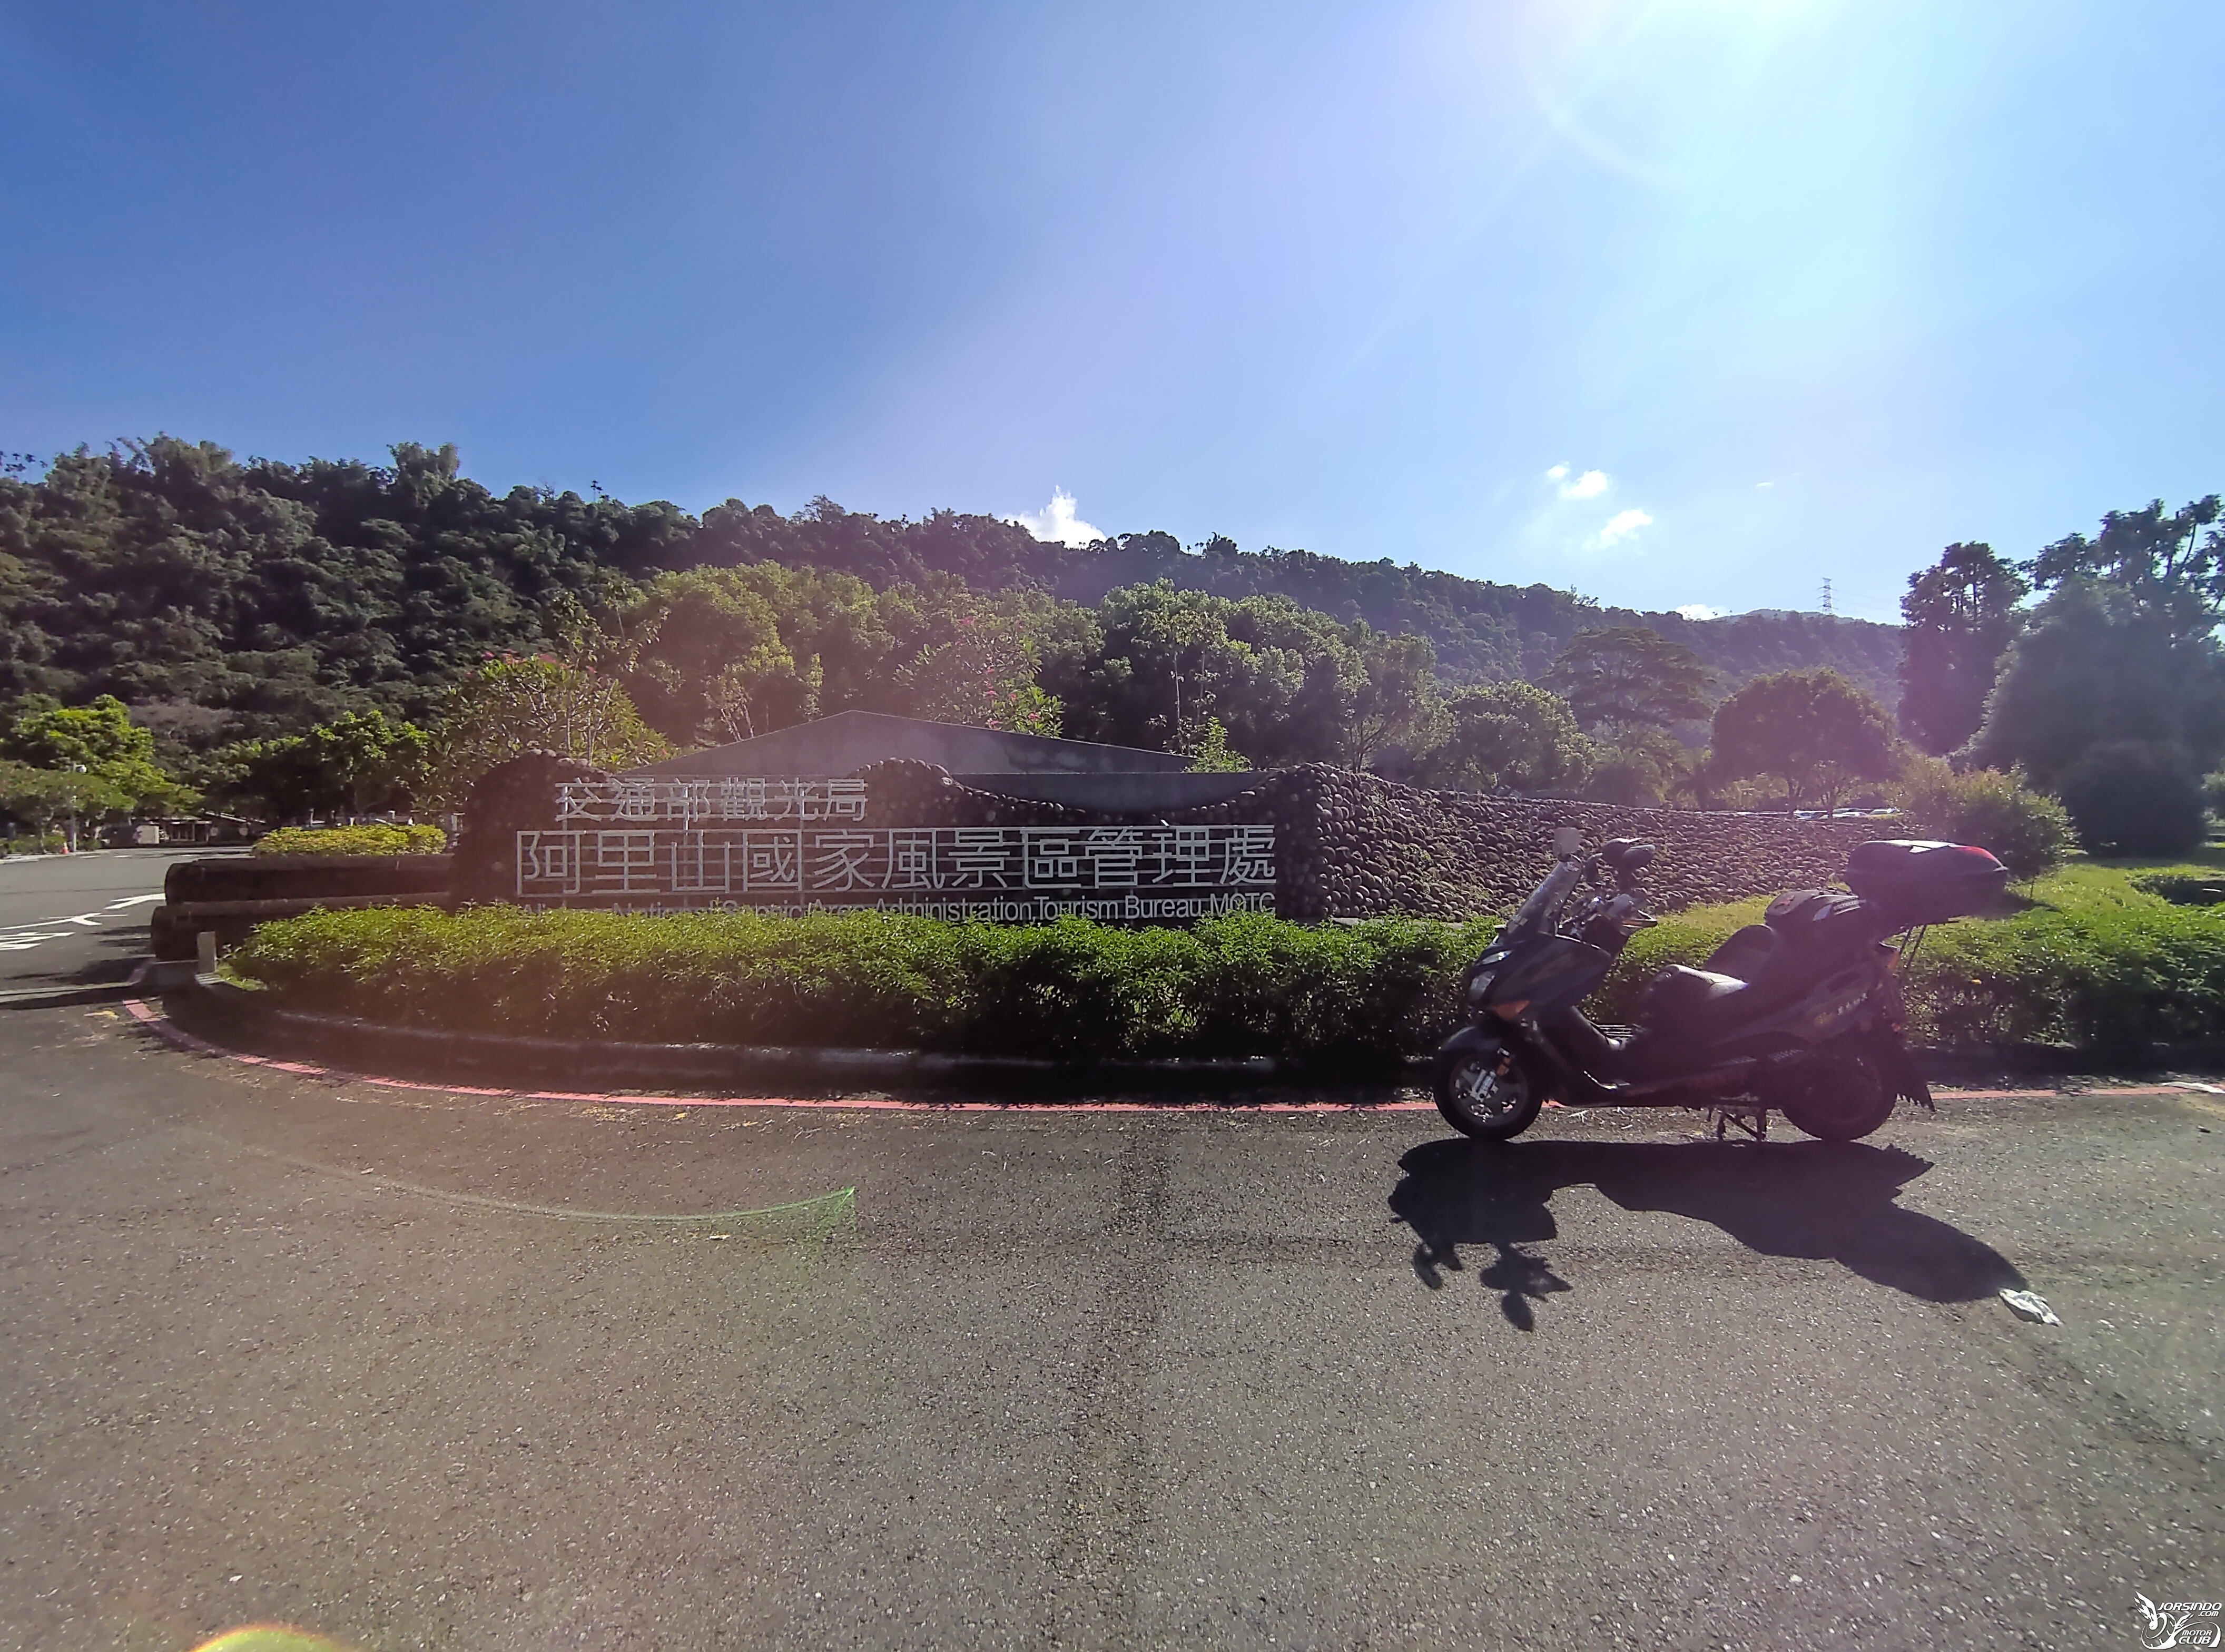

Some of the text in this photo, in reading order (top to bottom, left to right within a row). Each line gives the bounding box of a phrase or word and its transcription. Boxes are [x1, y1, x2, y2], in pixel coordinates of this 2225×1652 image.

[555, 776, 868, 822] 交通部觀光局
[517, 825, 1277, 895] 阿里山國家風景區管理處
[1125, 895, 1202, 919] Bureau
[1210, 892, 1276, 918] MOTC
